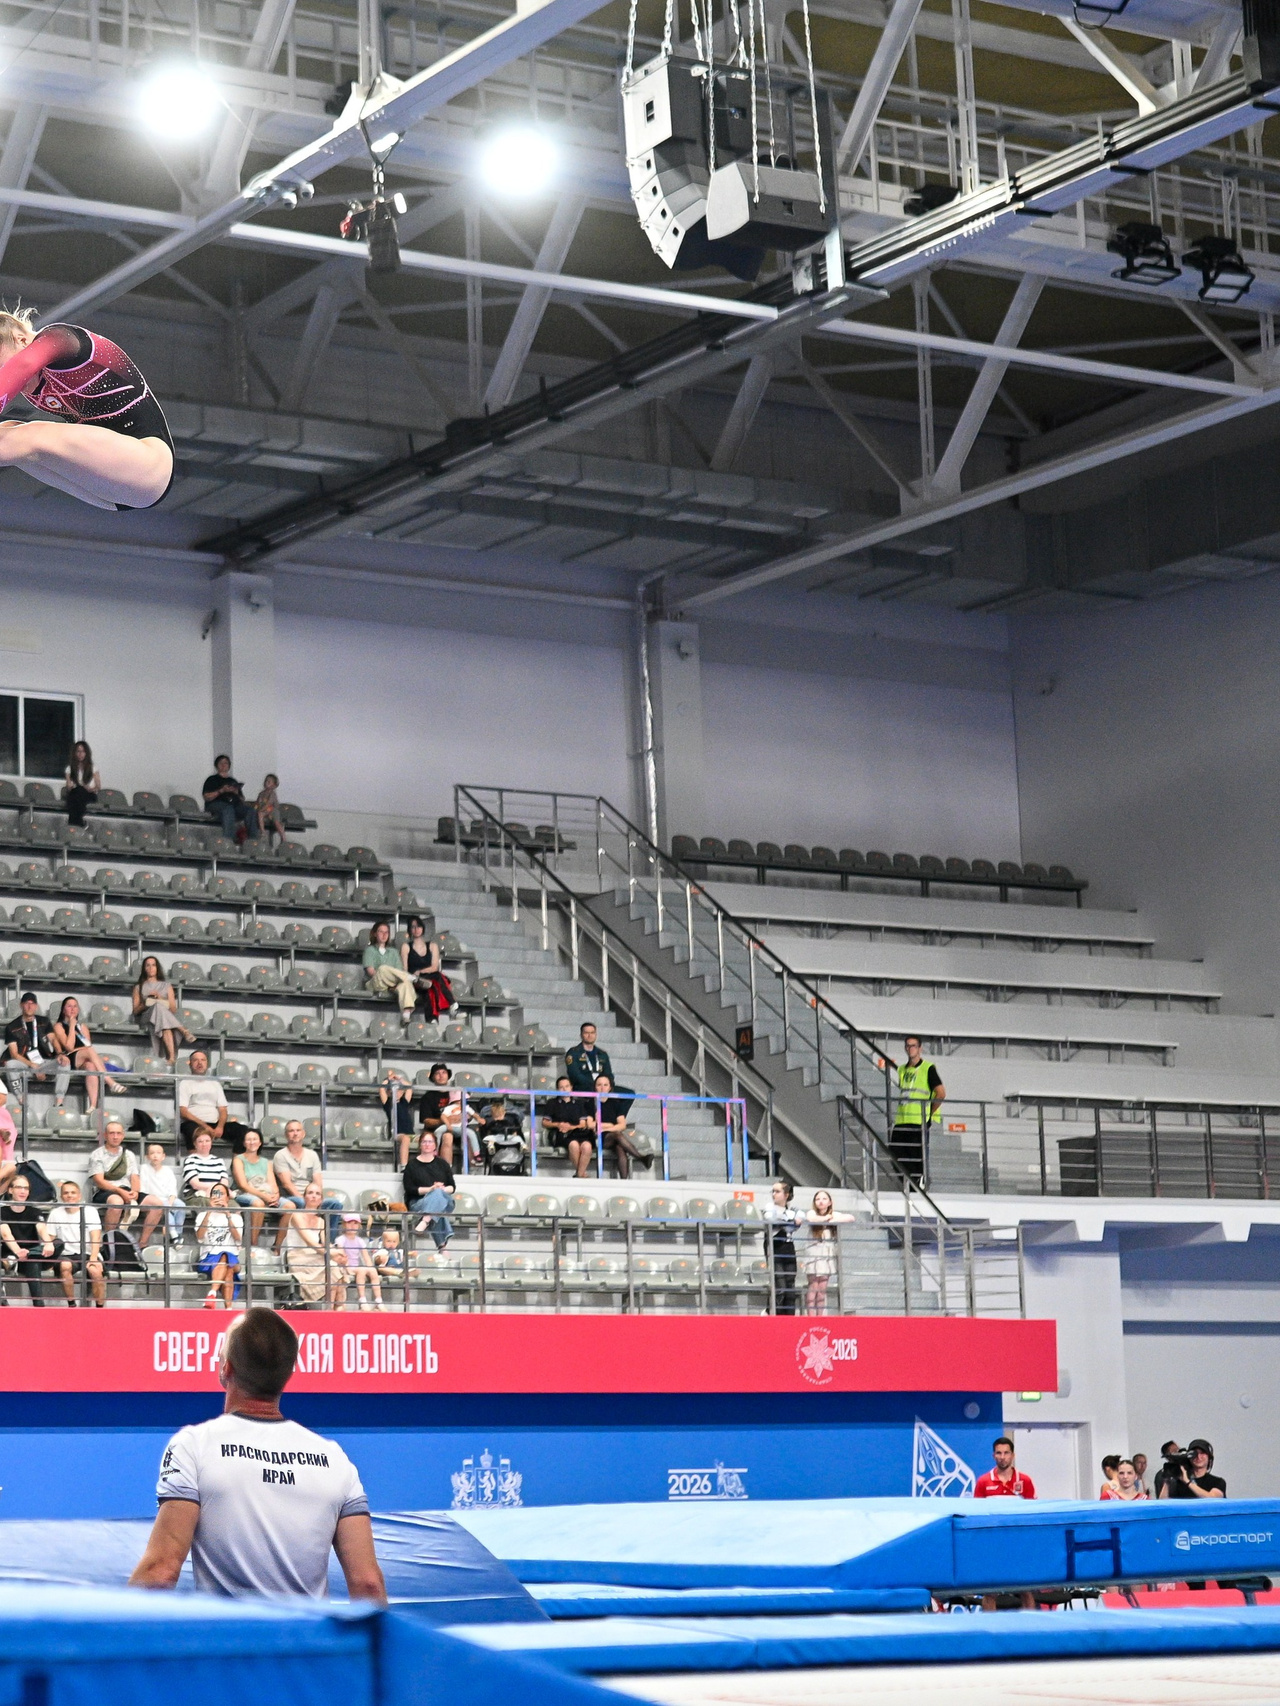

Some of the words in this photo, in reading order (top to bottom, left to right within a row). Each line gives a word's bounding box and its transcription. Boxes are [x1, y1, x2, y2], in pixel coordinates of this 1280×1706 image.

[153, 1331, 334, 1373] СВЕРДКАЯ
[342, 1333, 439, 1374] ОБЛАСТЬ
[832, 1338, 859, 1361] 2026
[220, 1444, 330, 1468] КРАСНОДАРСКИЙ
[262, 1468, 296, 1486] КРАЙ
[668, 1474, 712, 1495] 2026
[1190, 1532, 1274, 1547] акроспорт
